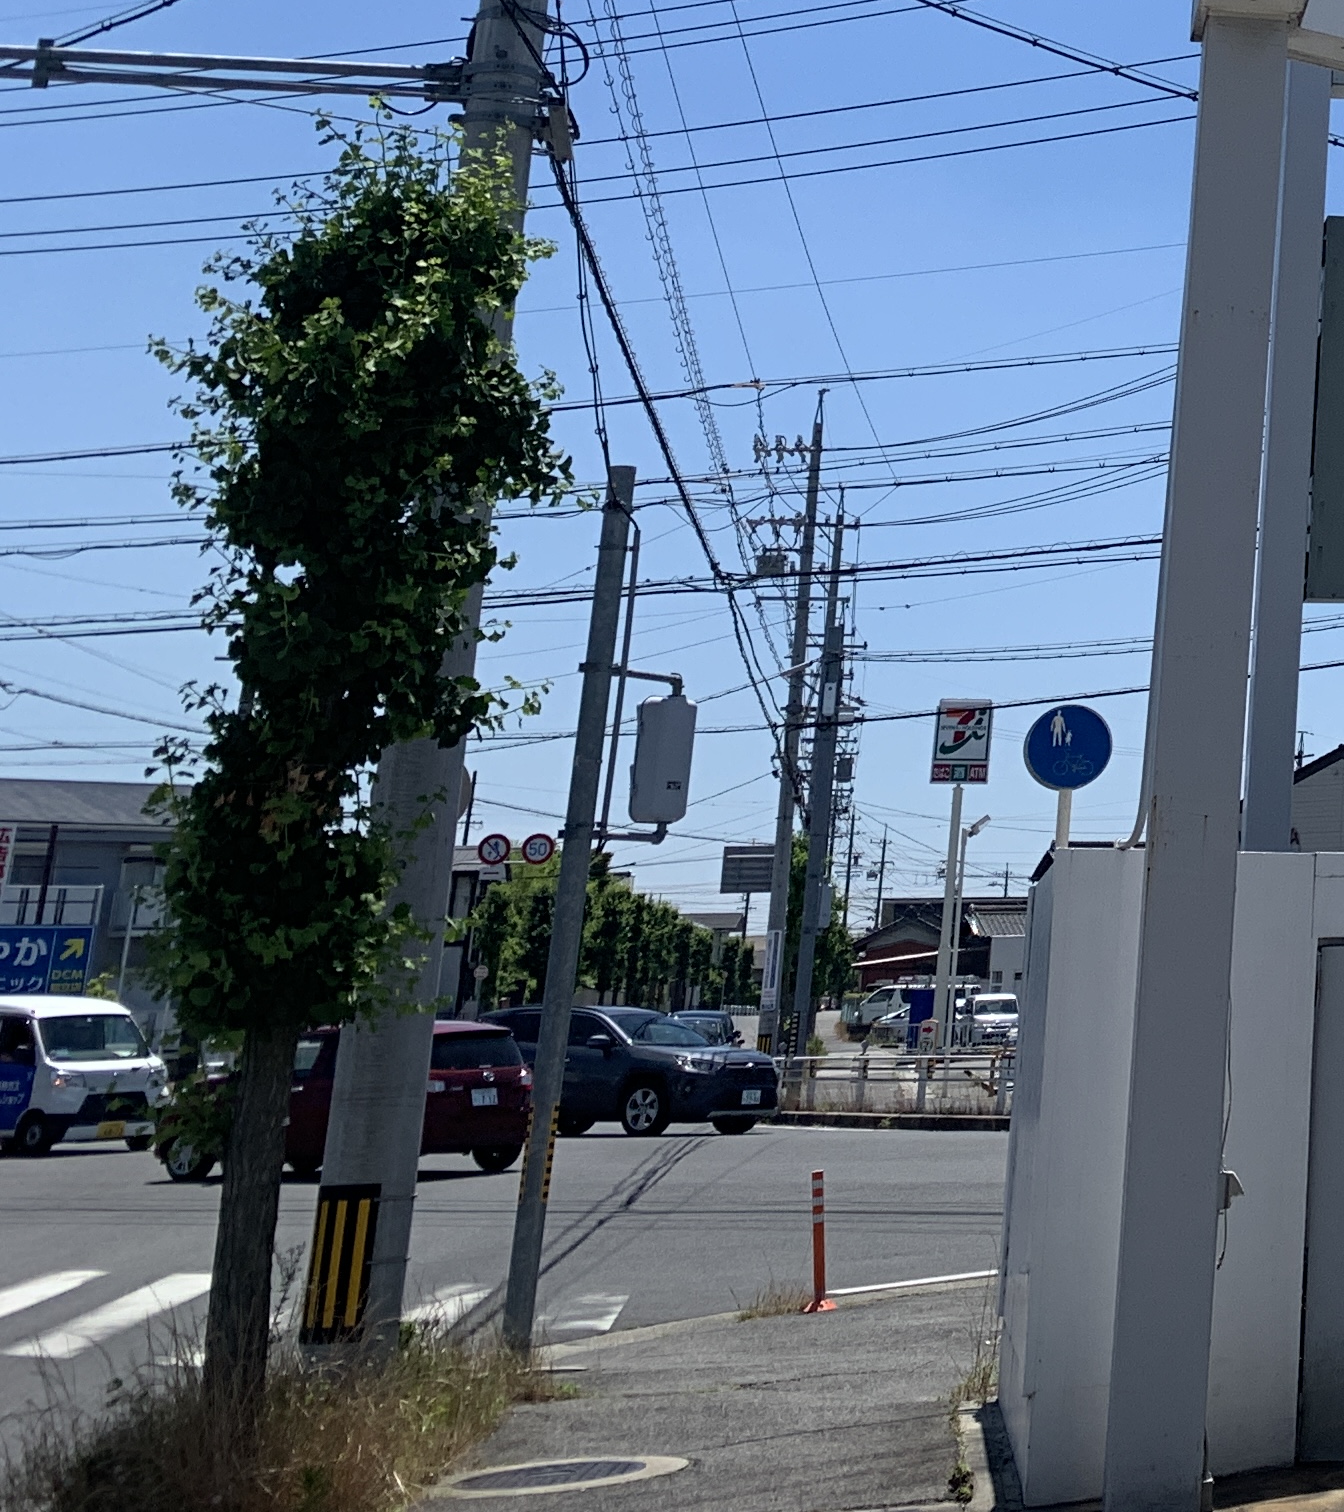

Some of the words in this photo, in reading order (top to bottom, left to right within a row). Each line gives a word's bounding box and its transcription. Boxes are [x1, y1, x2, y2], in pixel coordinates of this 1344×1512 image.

[969, 767, 987, 779] ATM
[528, 842, 548, 857] 50
[51, 969, 83, 981] DCM
